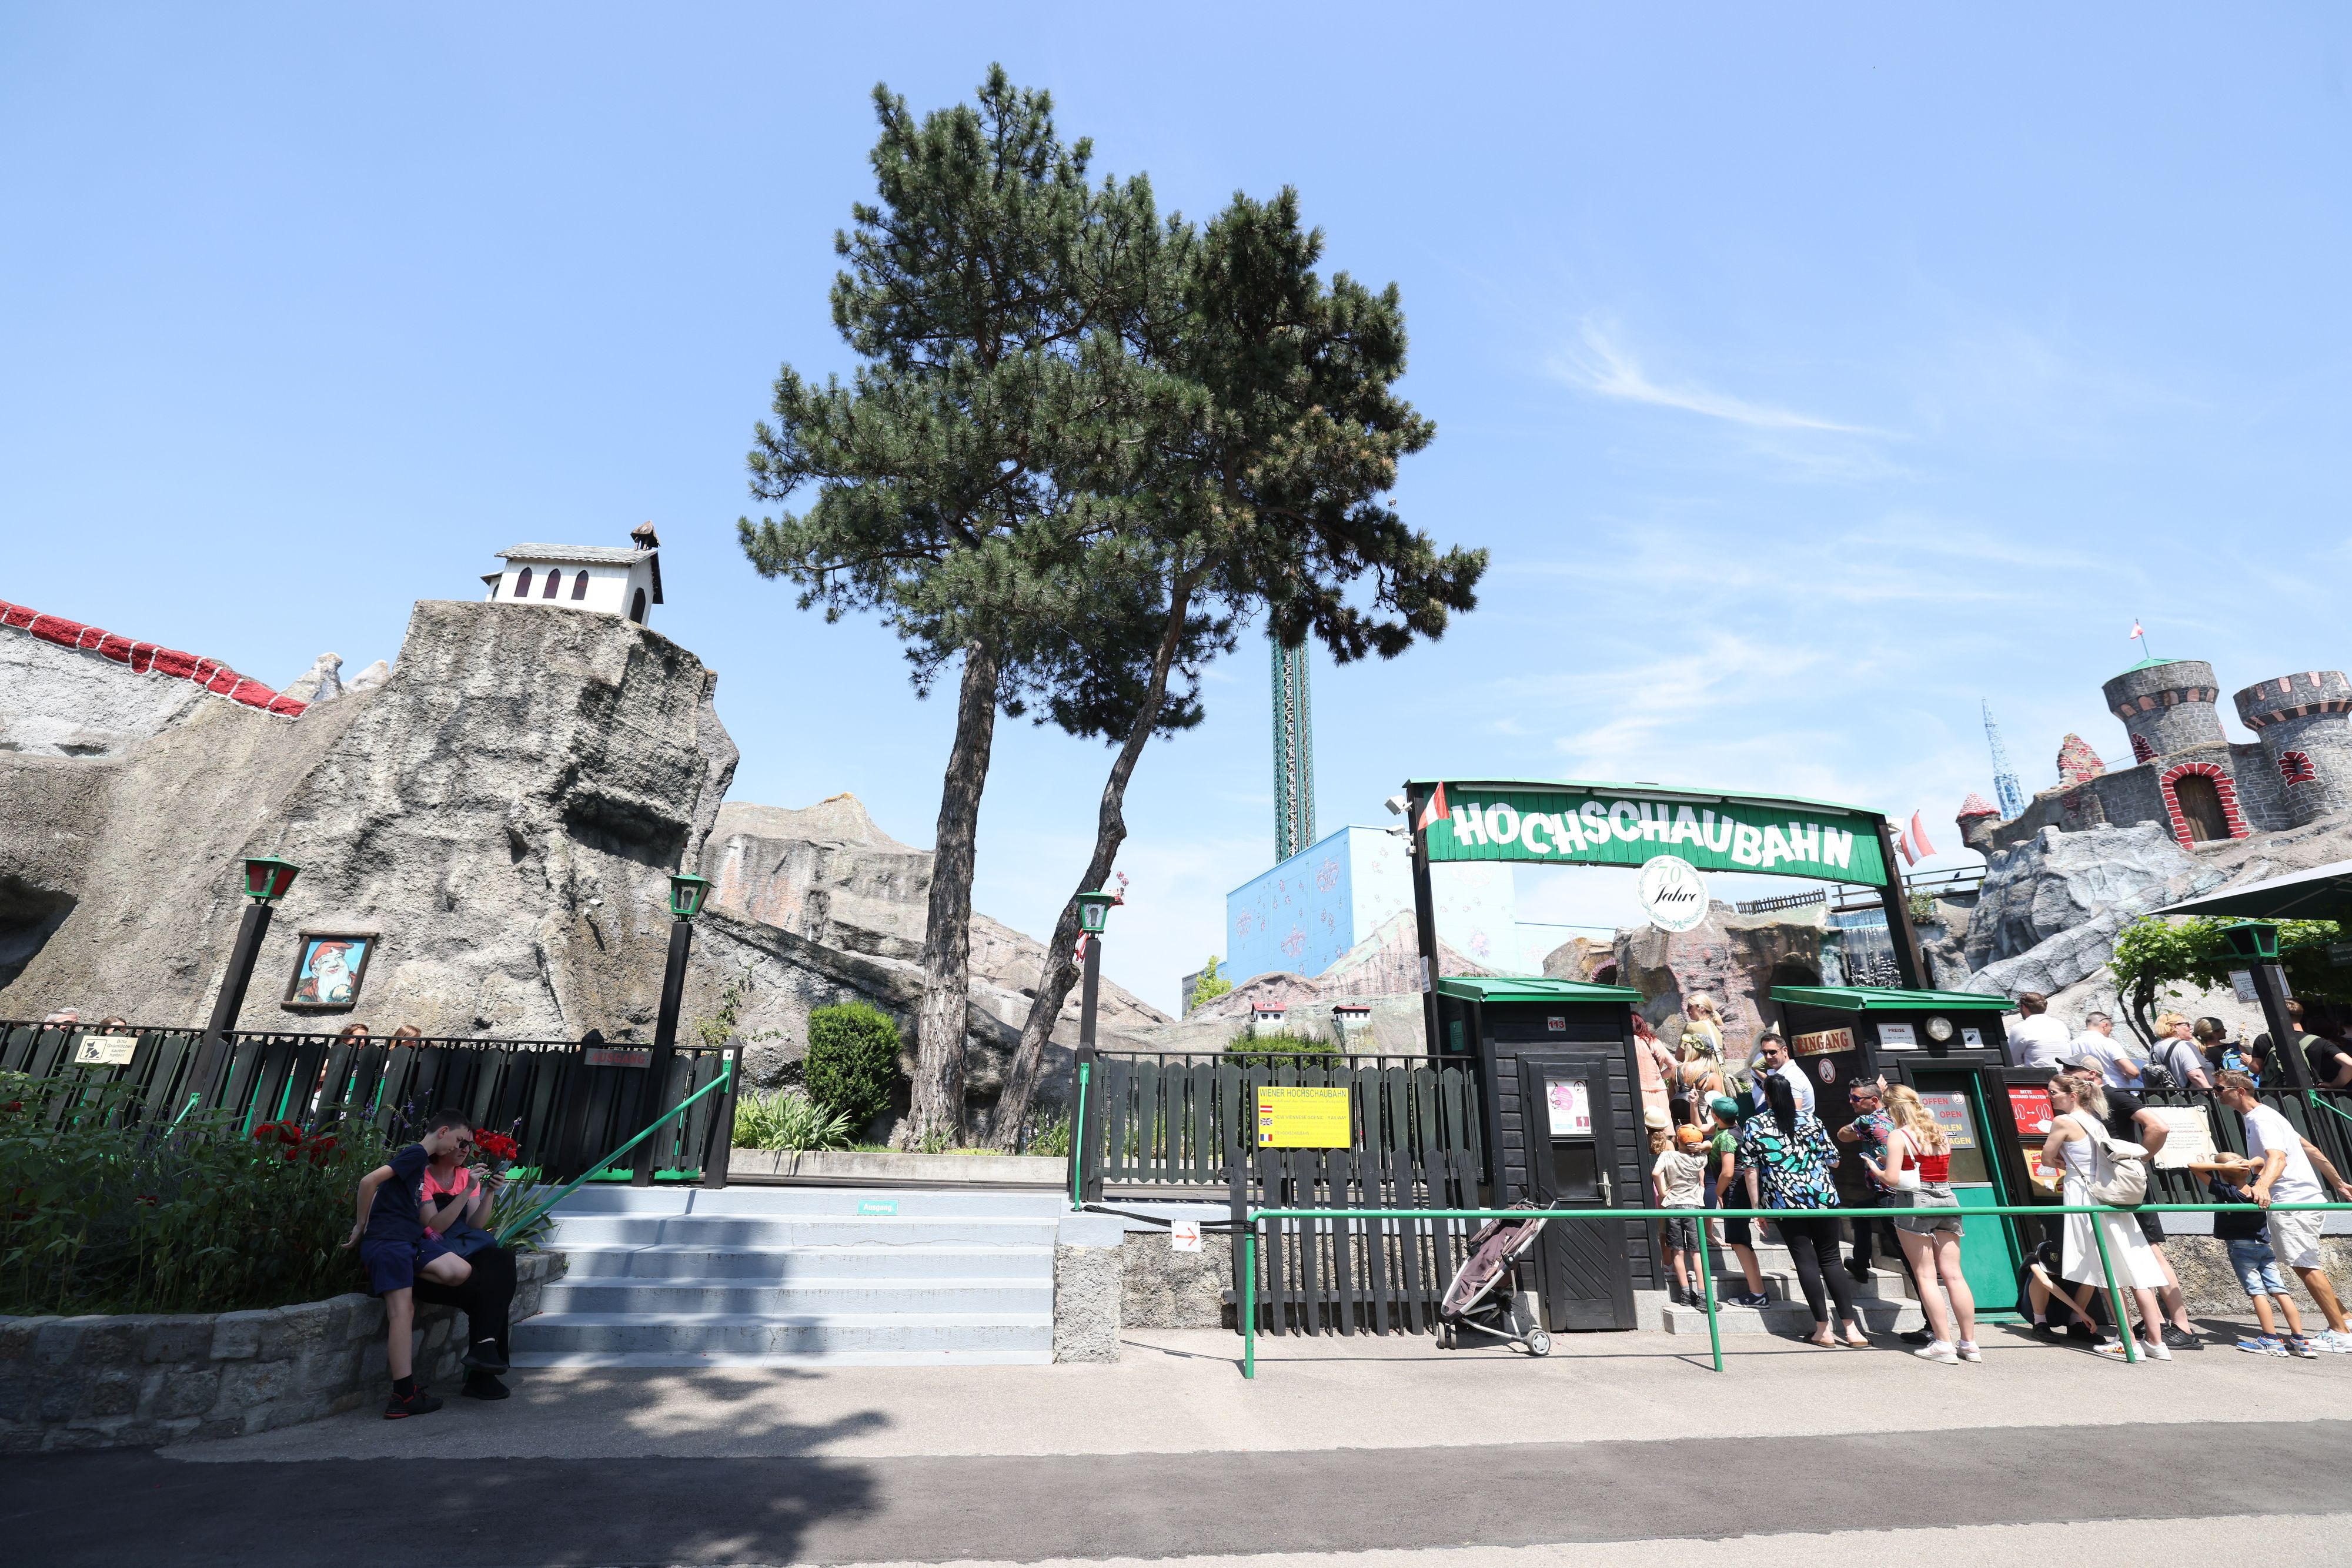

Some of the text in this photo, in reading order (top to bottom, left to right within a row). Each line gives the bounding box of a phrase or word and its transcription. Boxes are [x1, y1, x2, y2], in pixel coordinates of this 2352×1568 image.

[1450, 800, 1853, 869] HOCHSCHAUBAHN
[1658, 865, 1682, 883] 70
[1649, 883, 1698, 905] Jahre
[1796, 1031, 1849, 1052] EINGANG
[590, 1052, 646, 1065] AUSGANG
[1259, 1088, 1346, 1098] WIENER HOCHSCHAUBAHN
[863, 1203, 893, 1212] Ausgang
